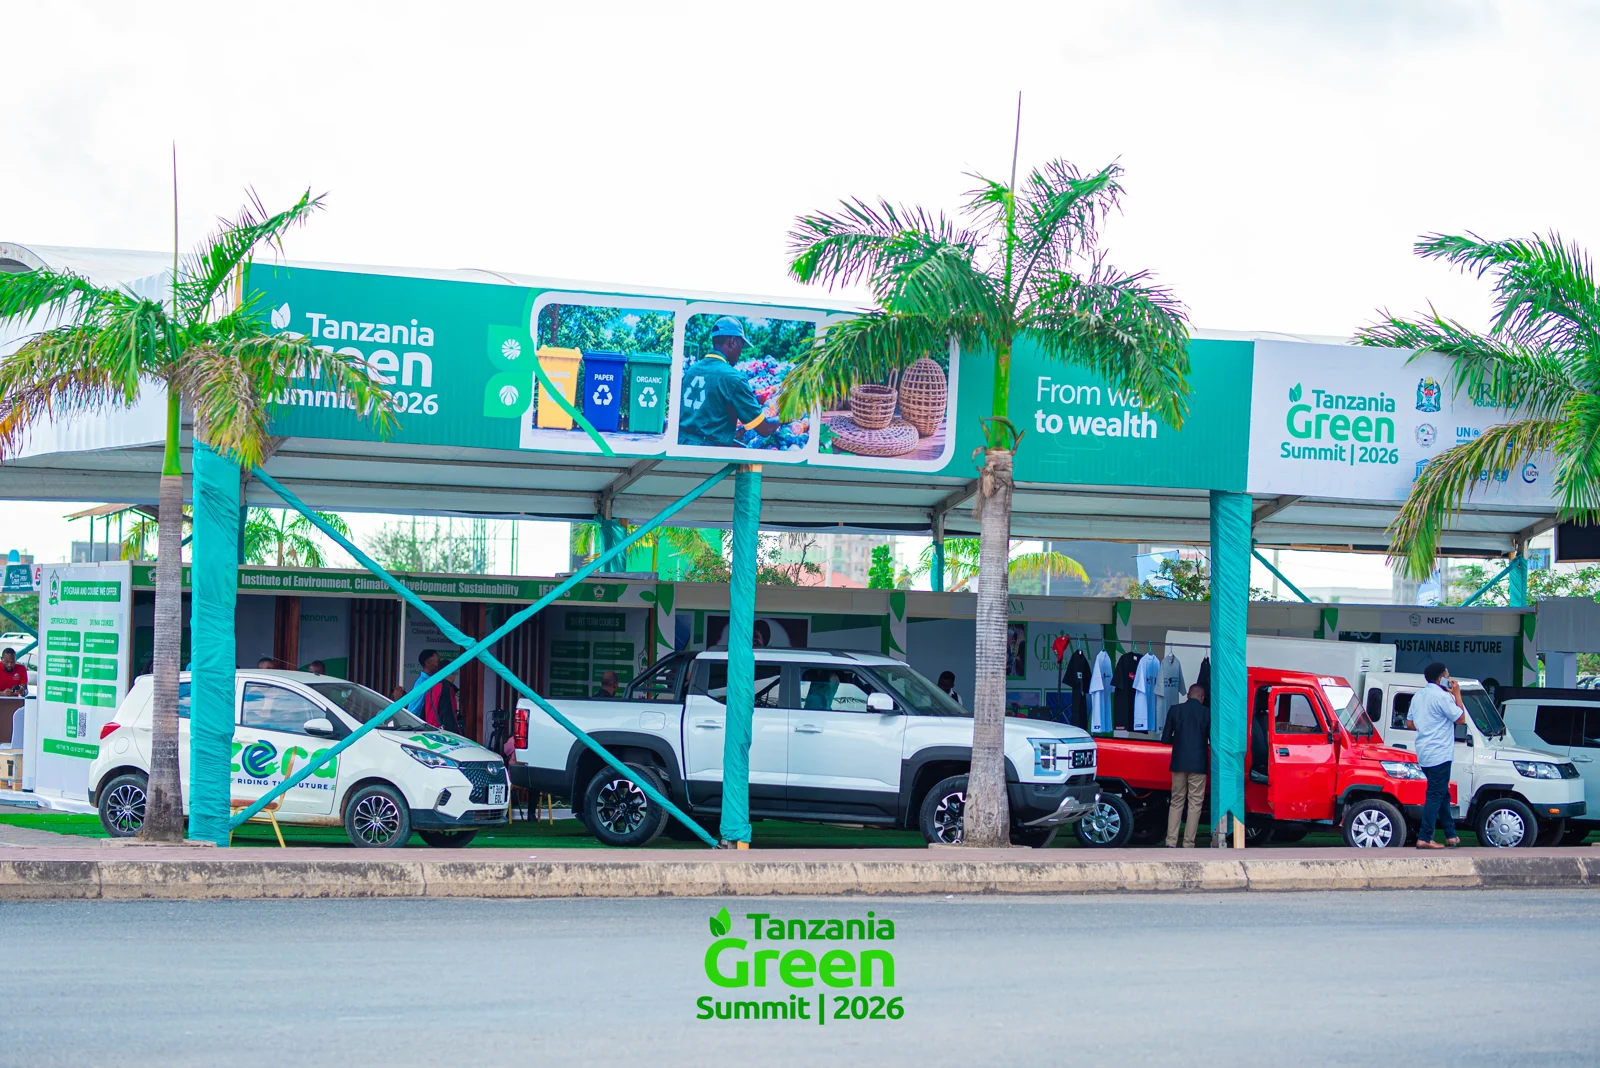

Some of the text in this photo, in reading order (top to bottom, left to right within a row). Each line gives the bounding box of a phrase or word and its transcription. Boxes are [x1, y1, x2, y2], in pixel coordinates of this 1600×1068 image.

[306, 312, 435, 347] Tanzania
[594, 373, 614, 381] PAPER
[636, 375, 662, 384] ORGANIC
[1036, 376, 1101, 405] From
[1311, 389, 1396, 412] Tanzania
[1035, 409, 1157, 438] to wealth
[1286, 403, 1395, 443] Green
[1456, 427, 1470, 437] UN
[1280, 441, 1346, 462] Summit
[1358, 447, 1399, 465] 2026
[241, 573, 281, 586] Institute
[283, 575, 292, 587] of
[294, 575, 353, 589] Environment,
[355, 578, 389, 590] Climate
[458, 581, 519, 597] Sustainability
[1427, 616, 1455, 625] NEMC
[1394, 639, 1502, 654] SUSTAINABLE FUTURE
[237, 778, 269, 786] RIDING
[297, 782, 328, 790] UTURE
